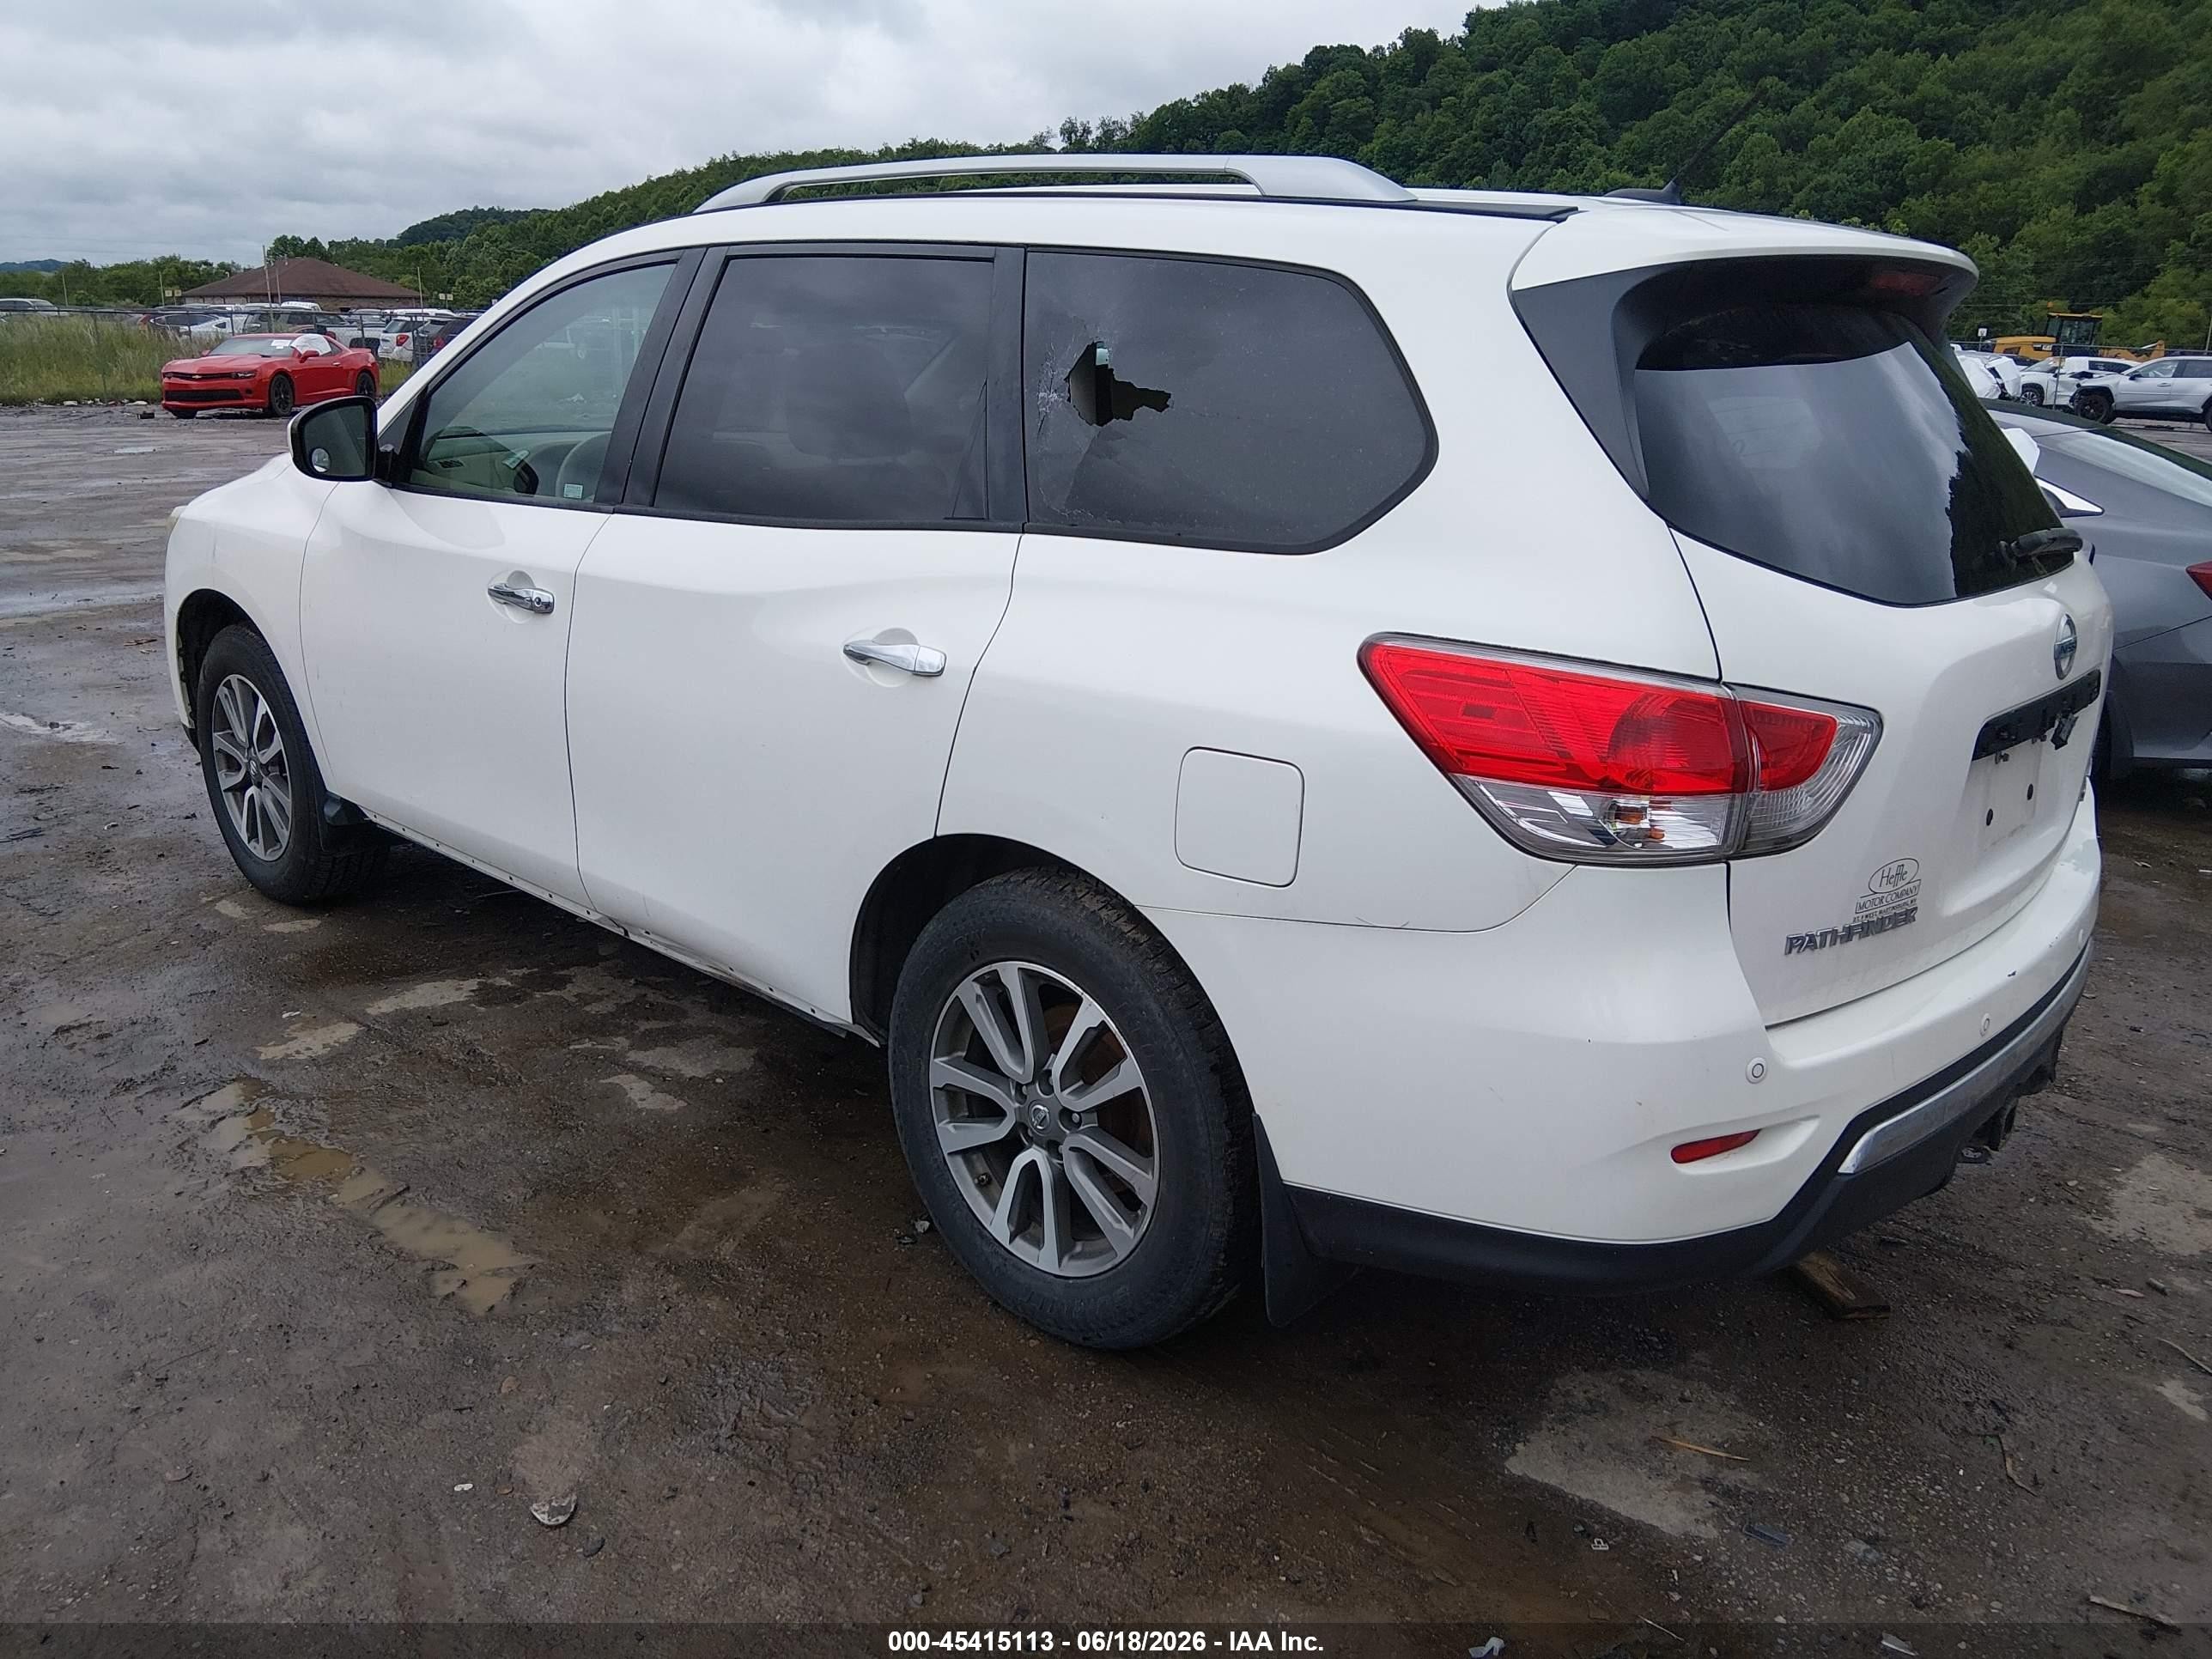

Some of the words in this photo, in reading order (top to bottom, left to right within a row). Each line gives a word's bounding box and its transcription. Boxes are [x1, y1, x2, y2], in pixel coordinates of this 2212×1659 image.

[1879, 864, 1908, 888] Heffle
[1857, 895, 1884, 911] MOTOR
[1886, 885, 1917, 903] COMPANY
[1784, 906, 1917, 955] PATHFINDER
